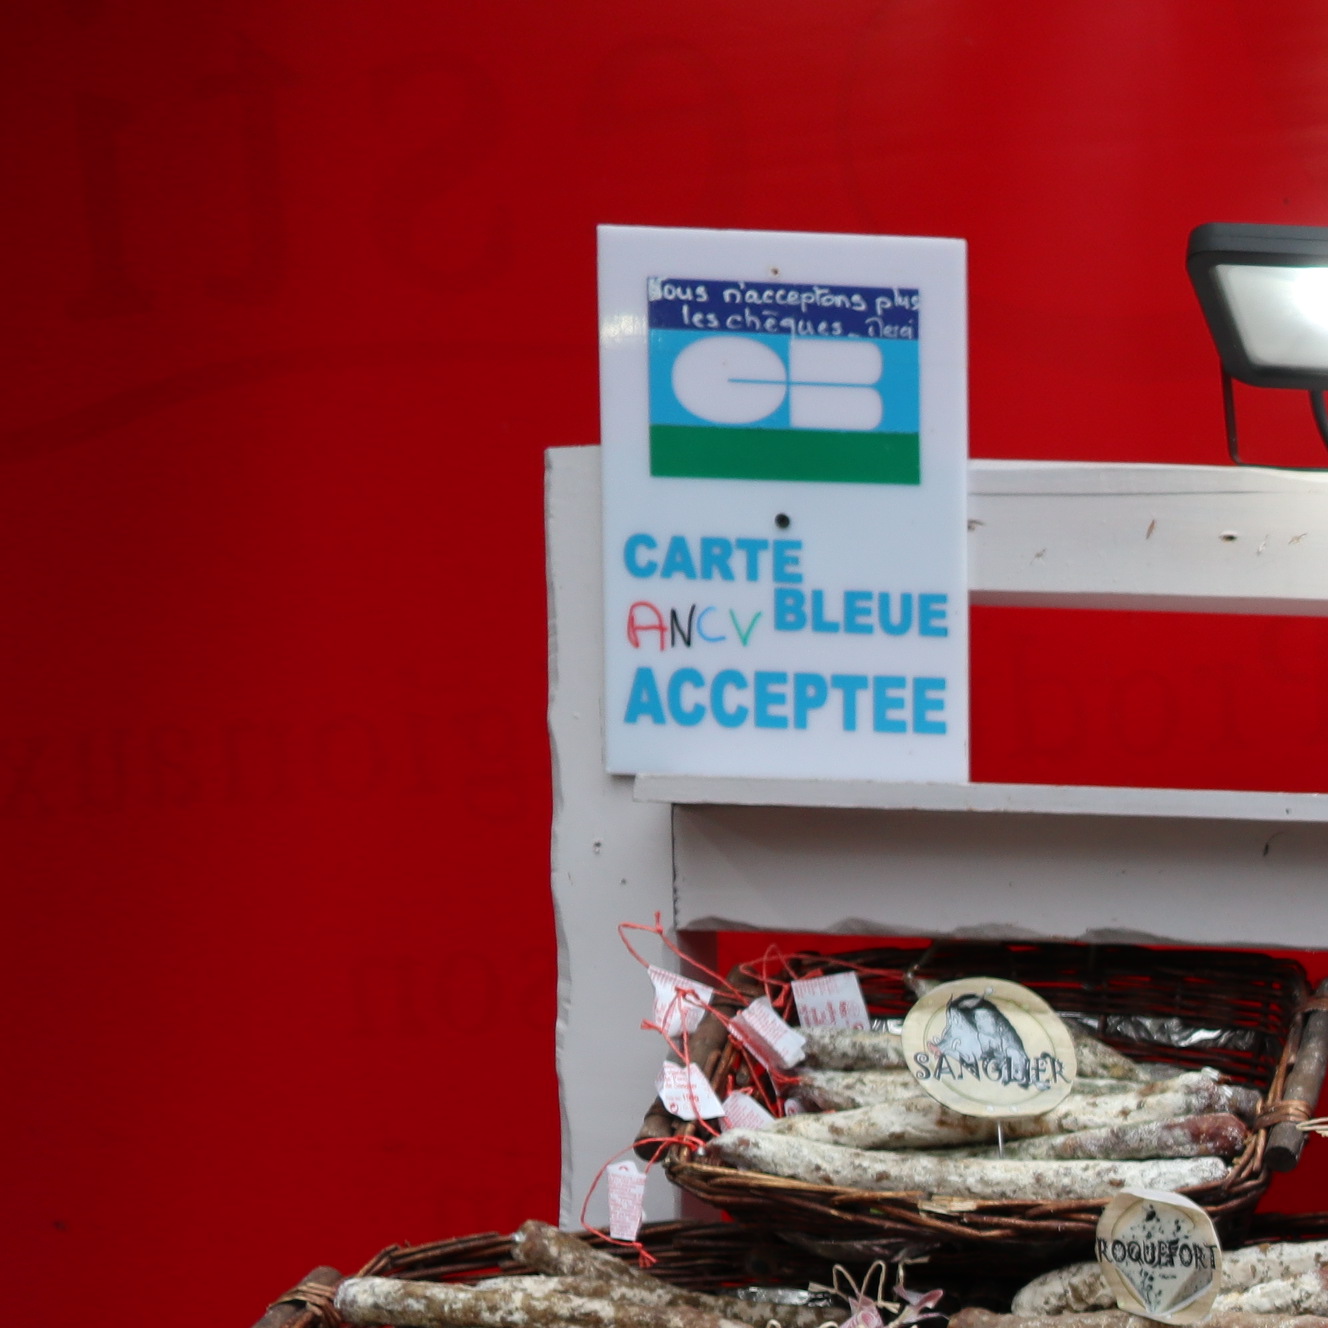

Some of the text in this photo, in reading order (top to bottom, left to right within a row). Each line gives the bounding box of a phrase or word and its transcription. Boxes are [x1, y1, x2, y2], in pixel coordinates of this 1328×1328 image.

[681, 304, 721, 329] les
[875, 286, 919, 315] plus
[623, 534, 806, 584] CARTE
[626, 600, 764, 651] ANCV
[773, 587, 949, 638] BLEUE
[623, 666, 948, 735] ACCEPTEE
[913, 1051, 1073, 1085] SANGLIER
[1096, 1237, 1218, 1272] ROQUEFORT
